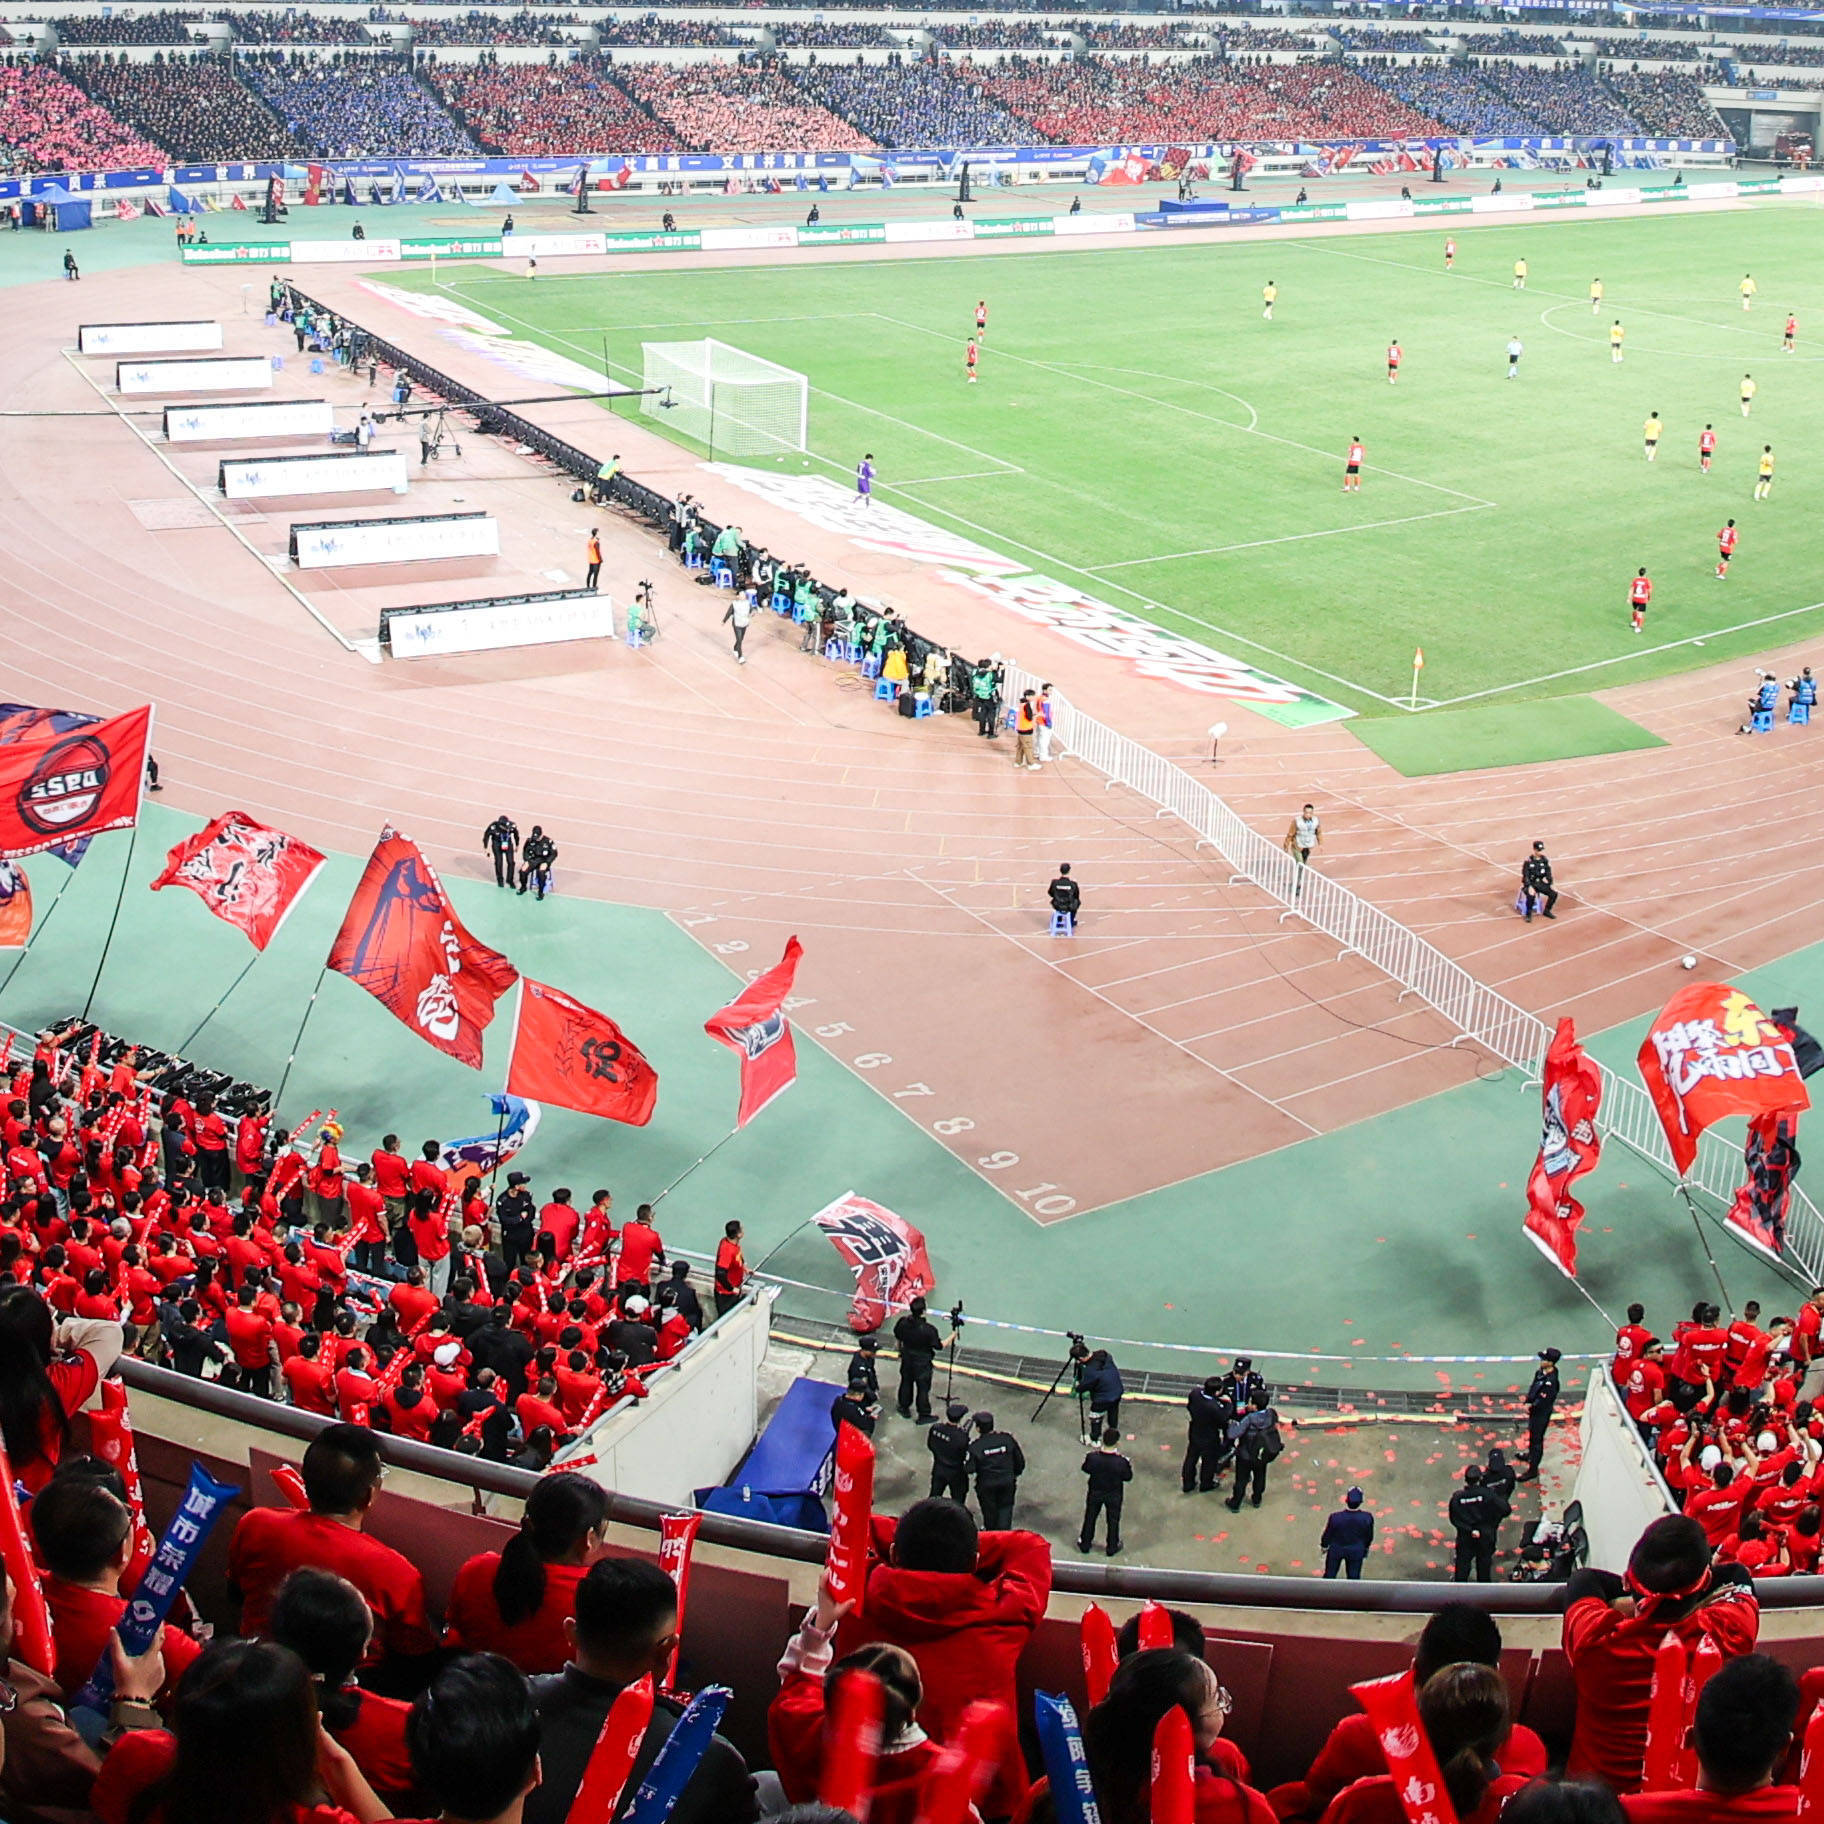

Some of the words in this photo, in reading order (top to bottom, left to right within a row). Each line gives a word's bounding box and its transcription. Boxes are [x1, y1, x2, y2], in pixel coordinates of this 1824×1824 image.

[682, 912, 719, 928] 1
[713, 938, 751, 955] 2
[815, 1021, 857, 1040] 5
[852, 1051, 894, 1071] 6
[892, 1083, 936, 1099] 7
[932, 1116, 976, 1137] 8
[977, 1150, 1021, 1172] 9
[1016, 1182, 1078, 1216] 10
[146, 1486, 218, 1596] 城市荣耀
